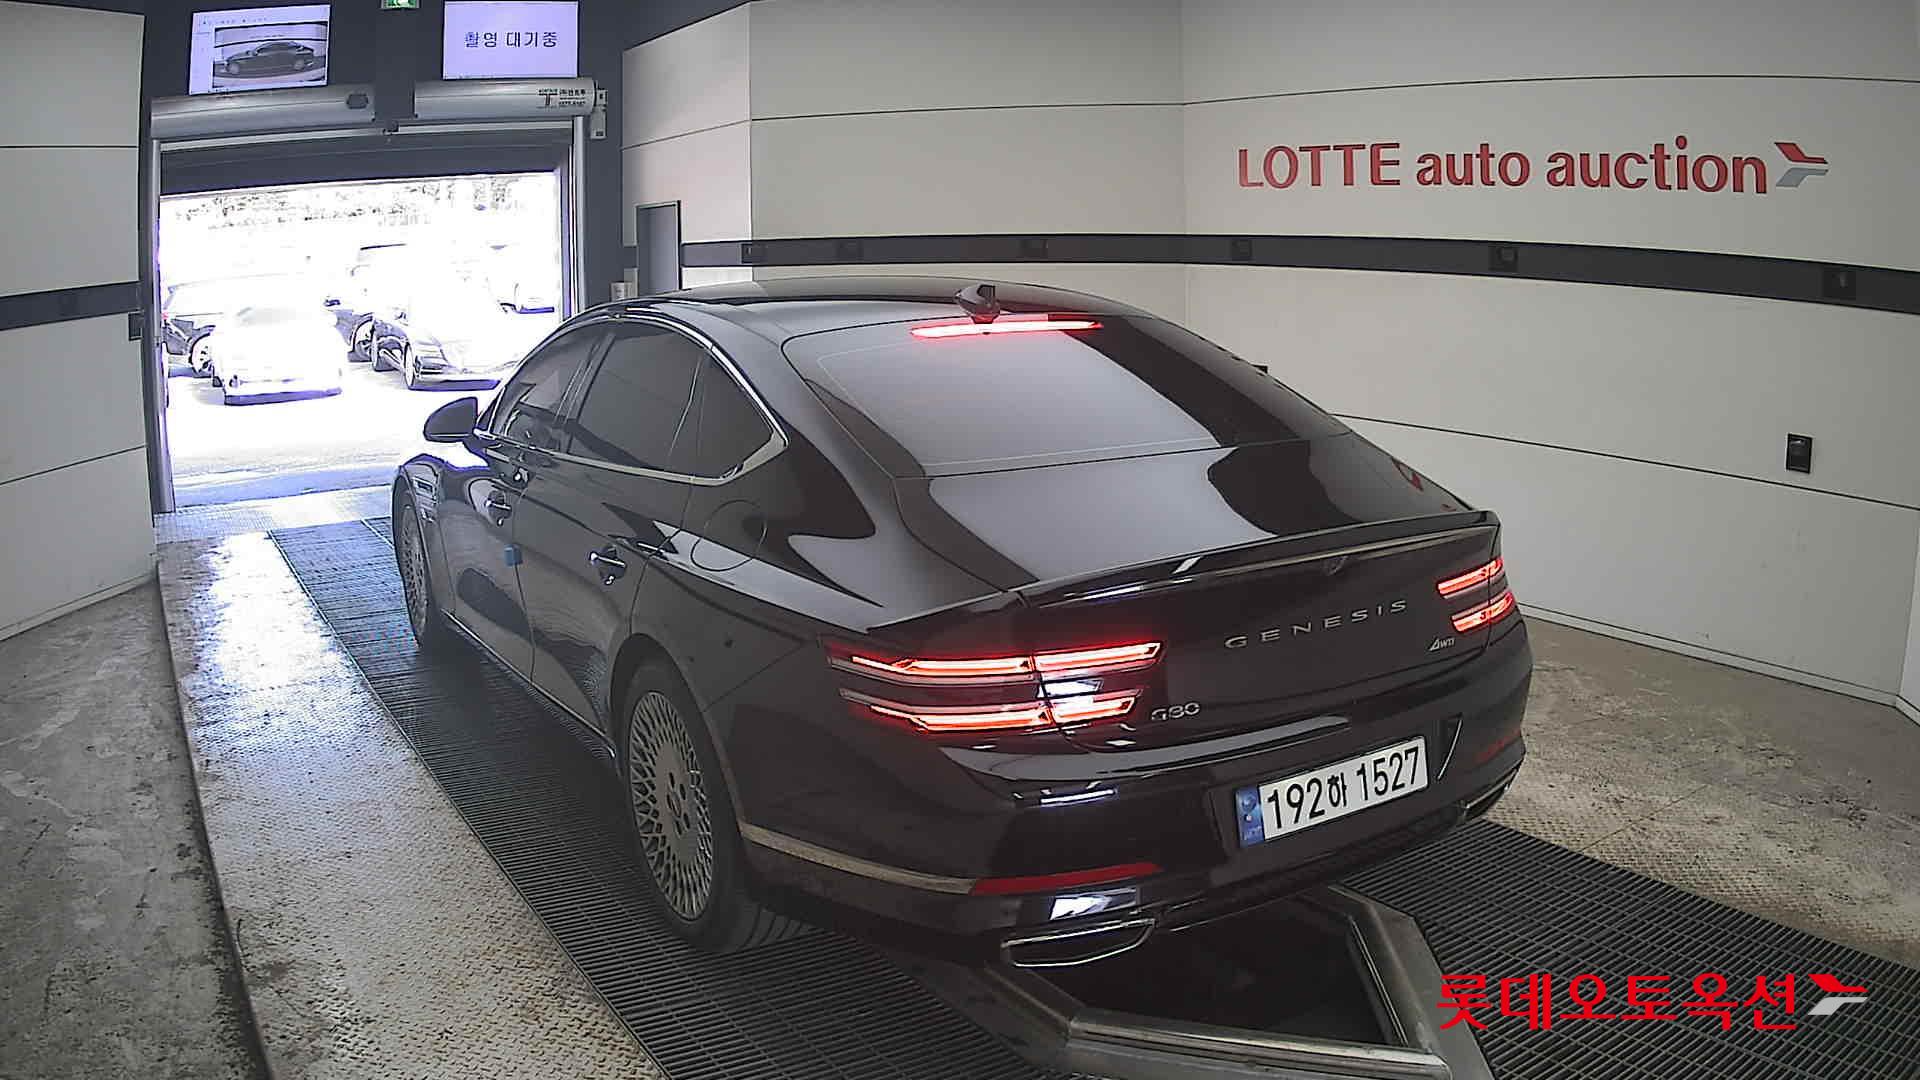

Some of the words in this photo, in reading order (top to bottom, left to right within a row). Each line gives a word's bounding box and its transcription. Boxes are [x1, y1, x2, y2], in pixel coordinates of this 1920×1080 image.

[505, 31, 558, 48] 대기중
[1238, 142, 1400, 188] LOTTE
[1416, 143, 1531, 187] auto
[1546, 135, 1767, 194] auction
[1224, 599, 1407, 649] GENESIS
[1151, 702, 1200, 721] G80
[1266, 771, 1347, 829] 192하
[1356, 746, 1419, 801] 1527
